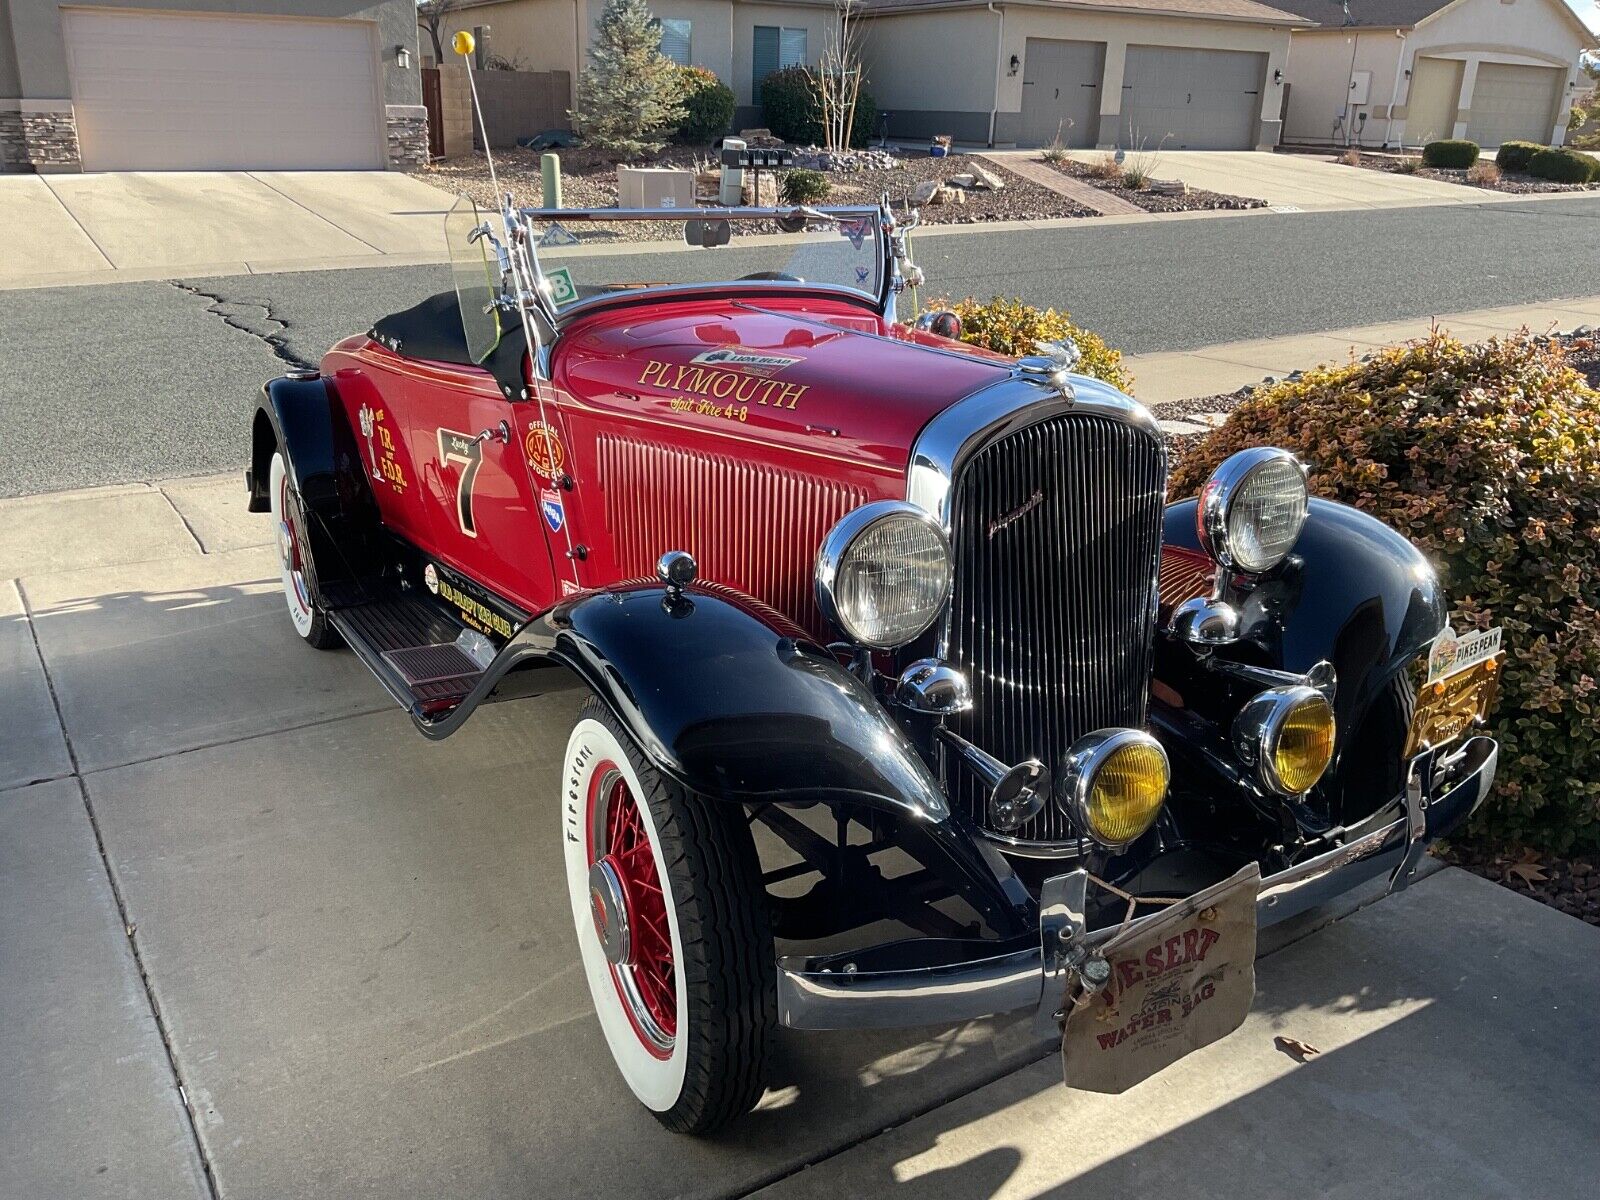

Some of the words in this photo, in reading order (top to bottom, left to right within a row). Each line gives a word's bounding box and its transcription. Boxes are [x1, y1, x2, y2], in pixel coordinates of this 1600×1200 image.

[759, 357, 792, 366] HEAD
[637, 360, 811, 410] PLYMOUTH
[670, 395, 694, 413] Spit
[696, 399, 722, 417] Fire
[528, 420, 559, 437] OFFIIAL
[451, 436, 470, 456] Lucky
[528, 458, 551, 479] STOCK
[437, 427, 484, 539] 7
[1456, 641, 1480, 663] PIKES
[1480, 632, 1499, 654] PEAK
[567, 745, 593, 843] Firestone
[1097, 1008, 1173, 1050] WATER
[1181, 982, 1216, 1019] BAG
